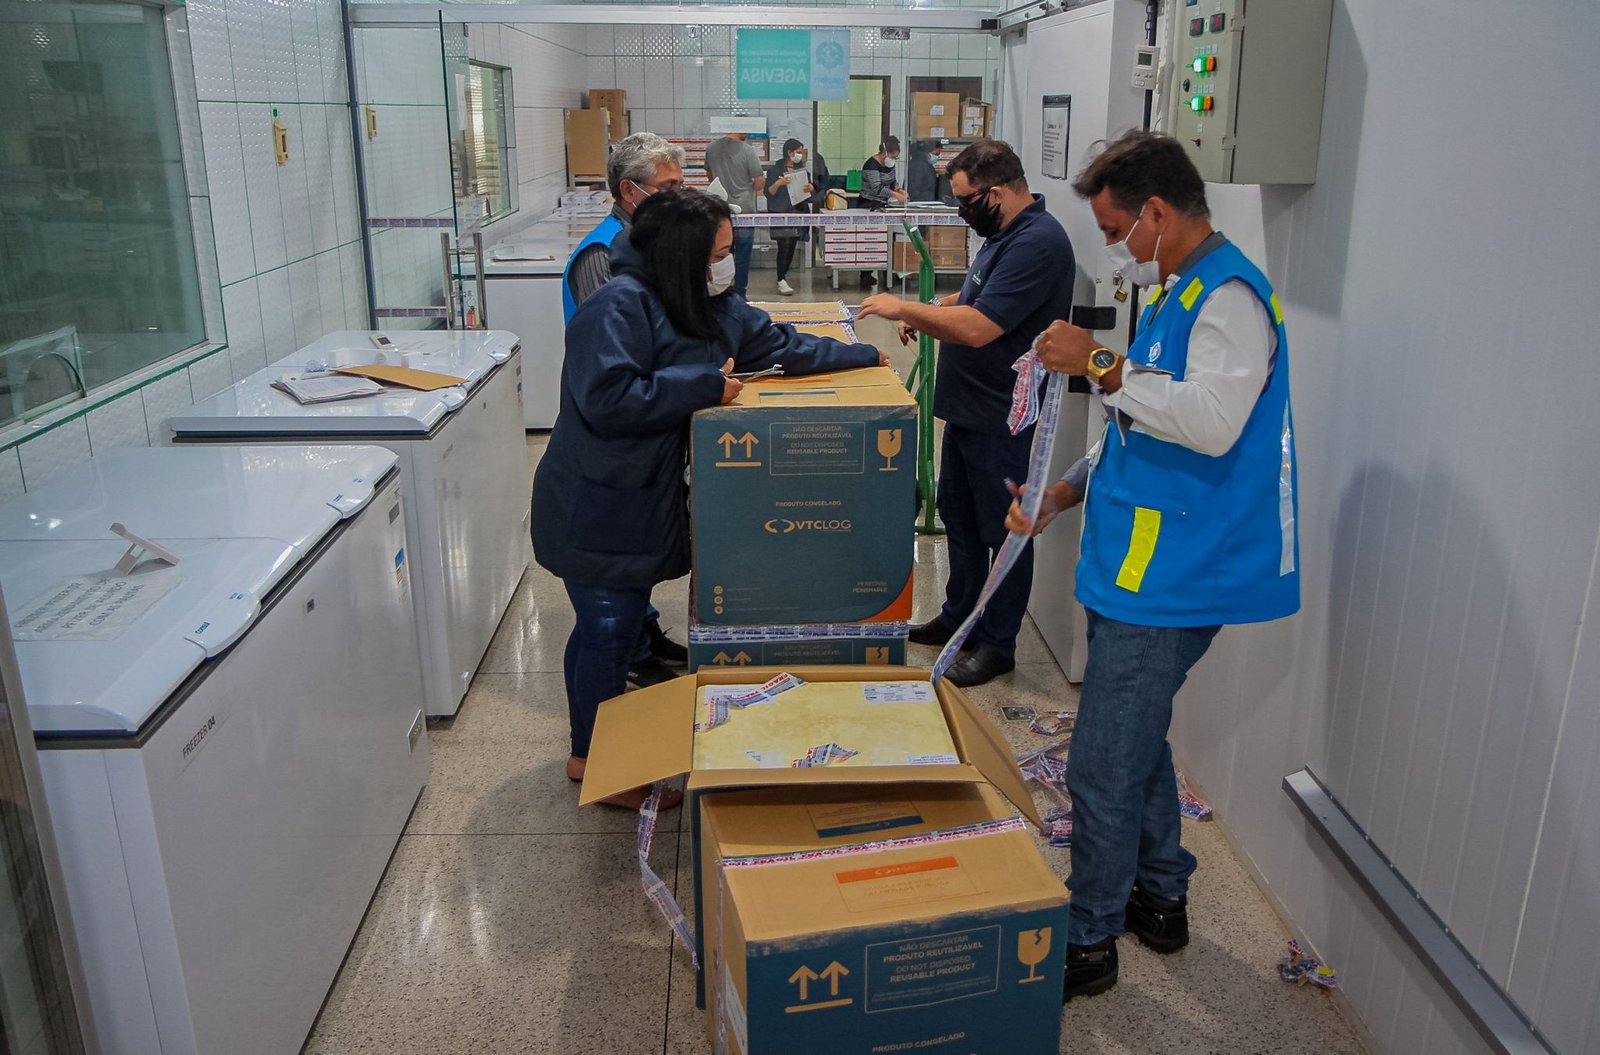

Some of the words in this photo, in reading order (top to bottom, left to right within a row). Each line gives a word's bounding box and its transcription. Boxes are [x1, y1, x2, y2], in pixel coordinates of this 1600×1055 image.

[782, 432, 811, 440] PRODUTO
[795, 519, 852, 530] VTCLOG
[182, 724, 208, 759] FREEZER
[207, 715, 216, 731] 04
[883, 951, 925, 963] PRODUTO
[926, 941, 984, 956] REUTILIZÁVEL
[899, 943, 918, 952] NÃO
[919, 935, 969, 949] DESCARTAR
[890, 971, 935, 983] REUSABLE
[936, 962, 977, 976] PRODUCT
[895, 965, 909, 973] DO
[910, 962, 928, 971] NOT
[929, 955, 971, 968] DISPOSED
[872, 1042, 913, 1053] PRODUTO
[914, 1031, 966, 1047] CONGELADO
